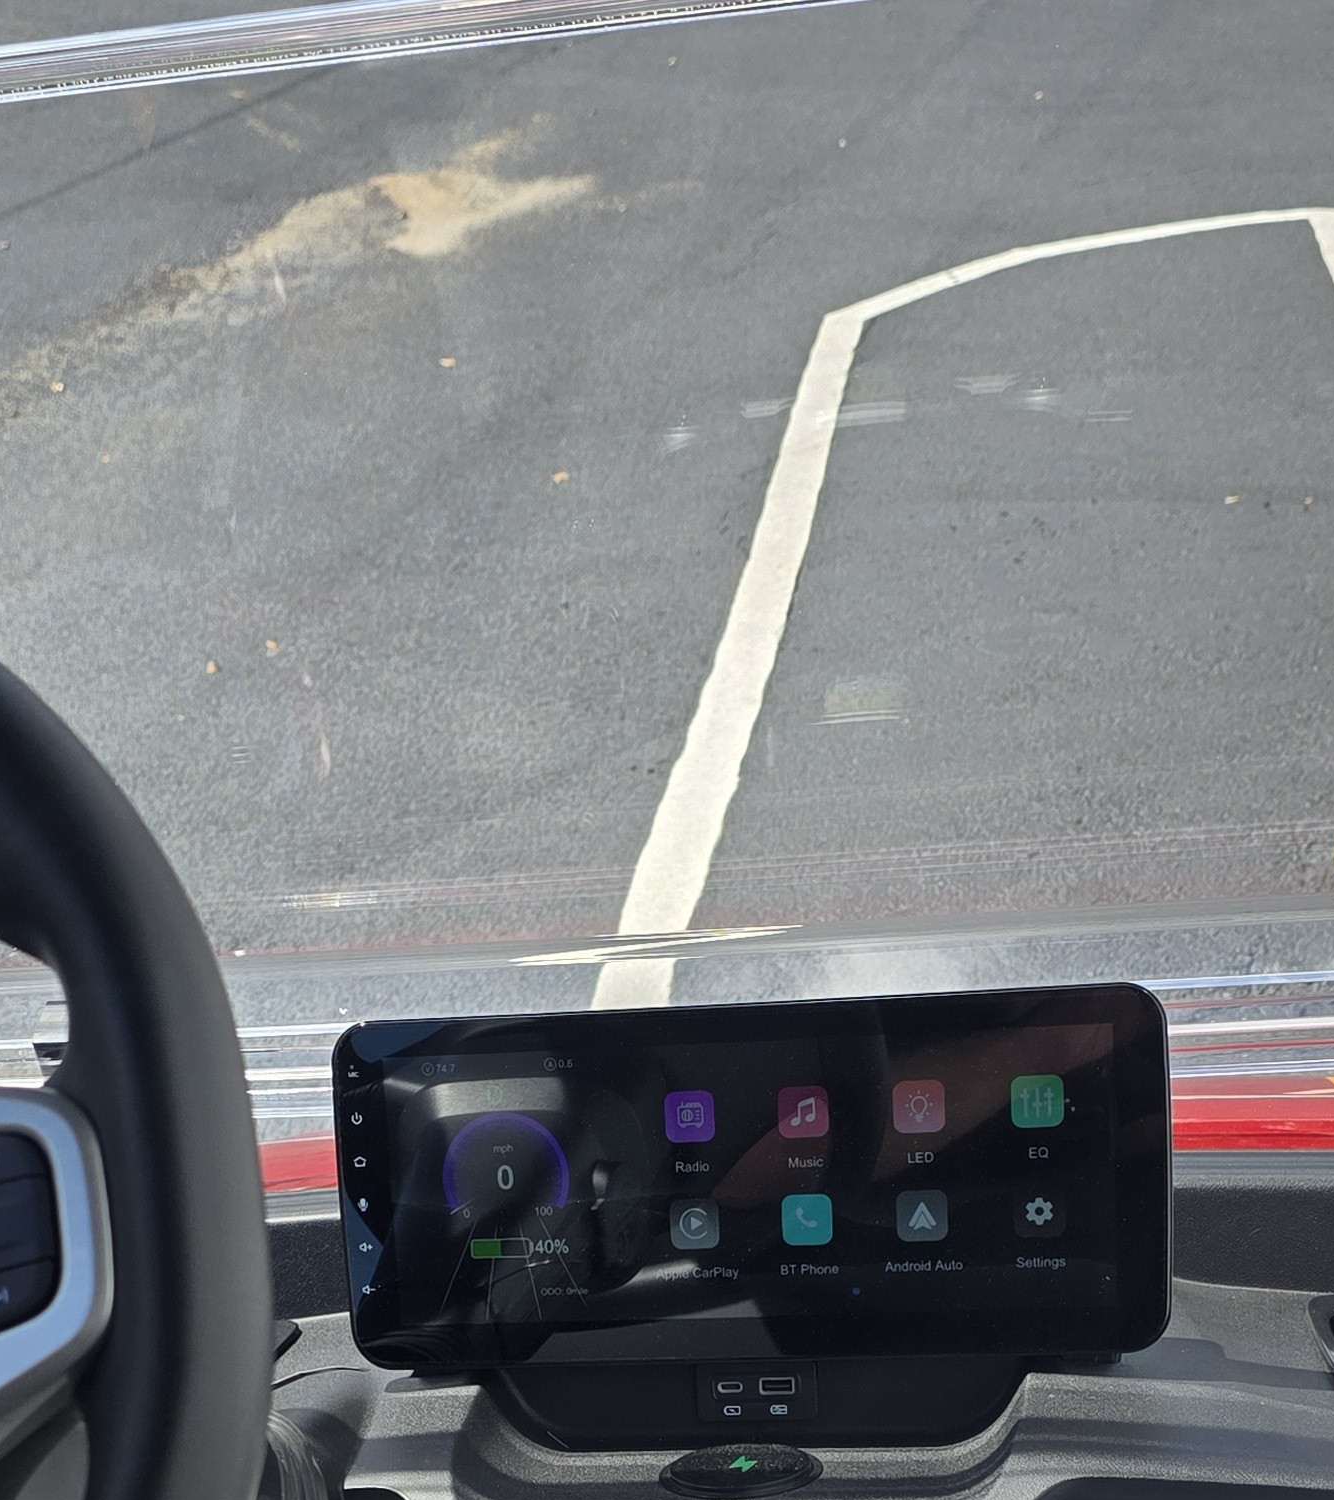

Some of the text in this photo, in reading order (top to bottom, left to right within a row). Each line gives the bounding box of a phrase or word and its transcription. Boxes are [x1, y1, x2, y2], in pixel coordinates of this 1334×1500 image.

[435, 1063, 456, 1074] 74.7
[493, 1144, 514, 1155] mph
[1027, 1146, 1050, 1160] EQ
[787, 1155, 824, 1168] Music
[907, 1151, 934, 1164] LED
[675, 1159, 710, 1173] Radio
[496, 1163, 515, 1191] 0
[535, 1205, 554, 1217] 100
[534, 1238, 569, 1255] 40%
[780, 1262, 840, 1276] BT Phone
[885, 1258, 964, 1273] Android Auto
[1016, 1255, 1067, 1270] Settings
[656, 1265, 740, 1281] Apple CarPlay
